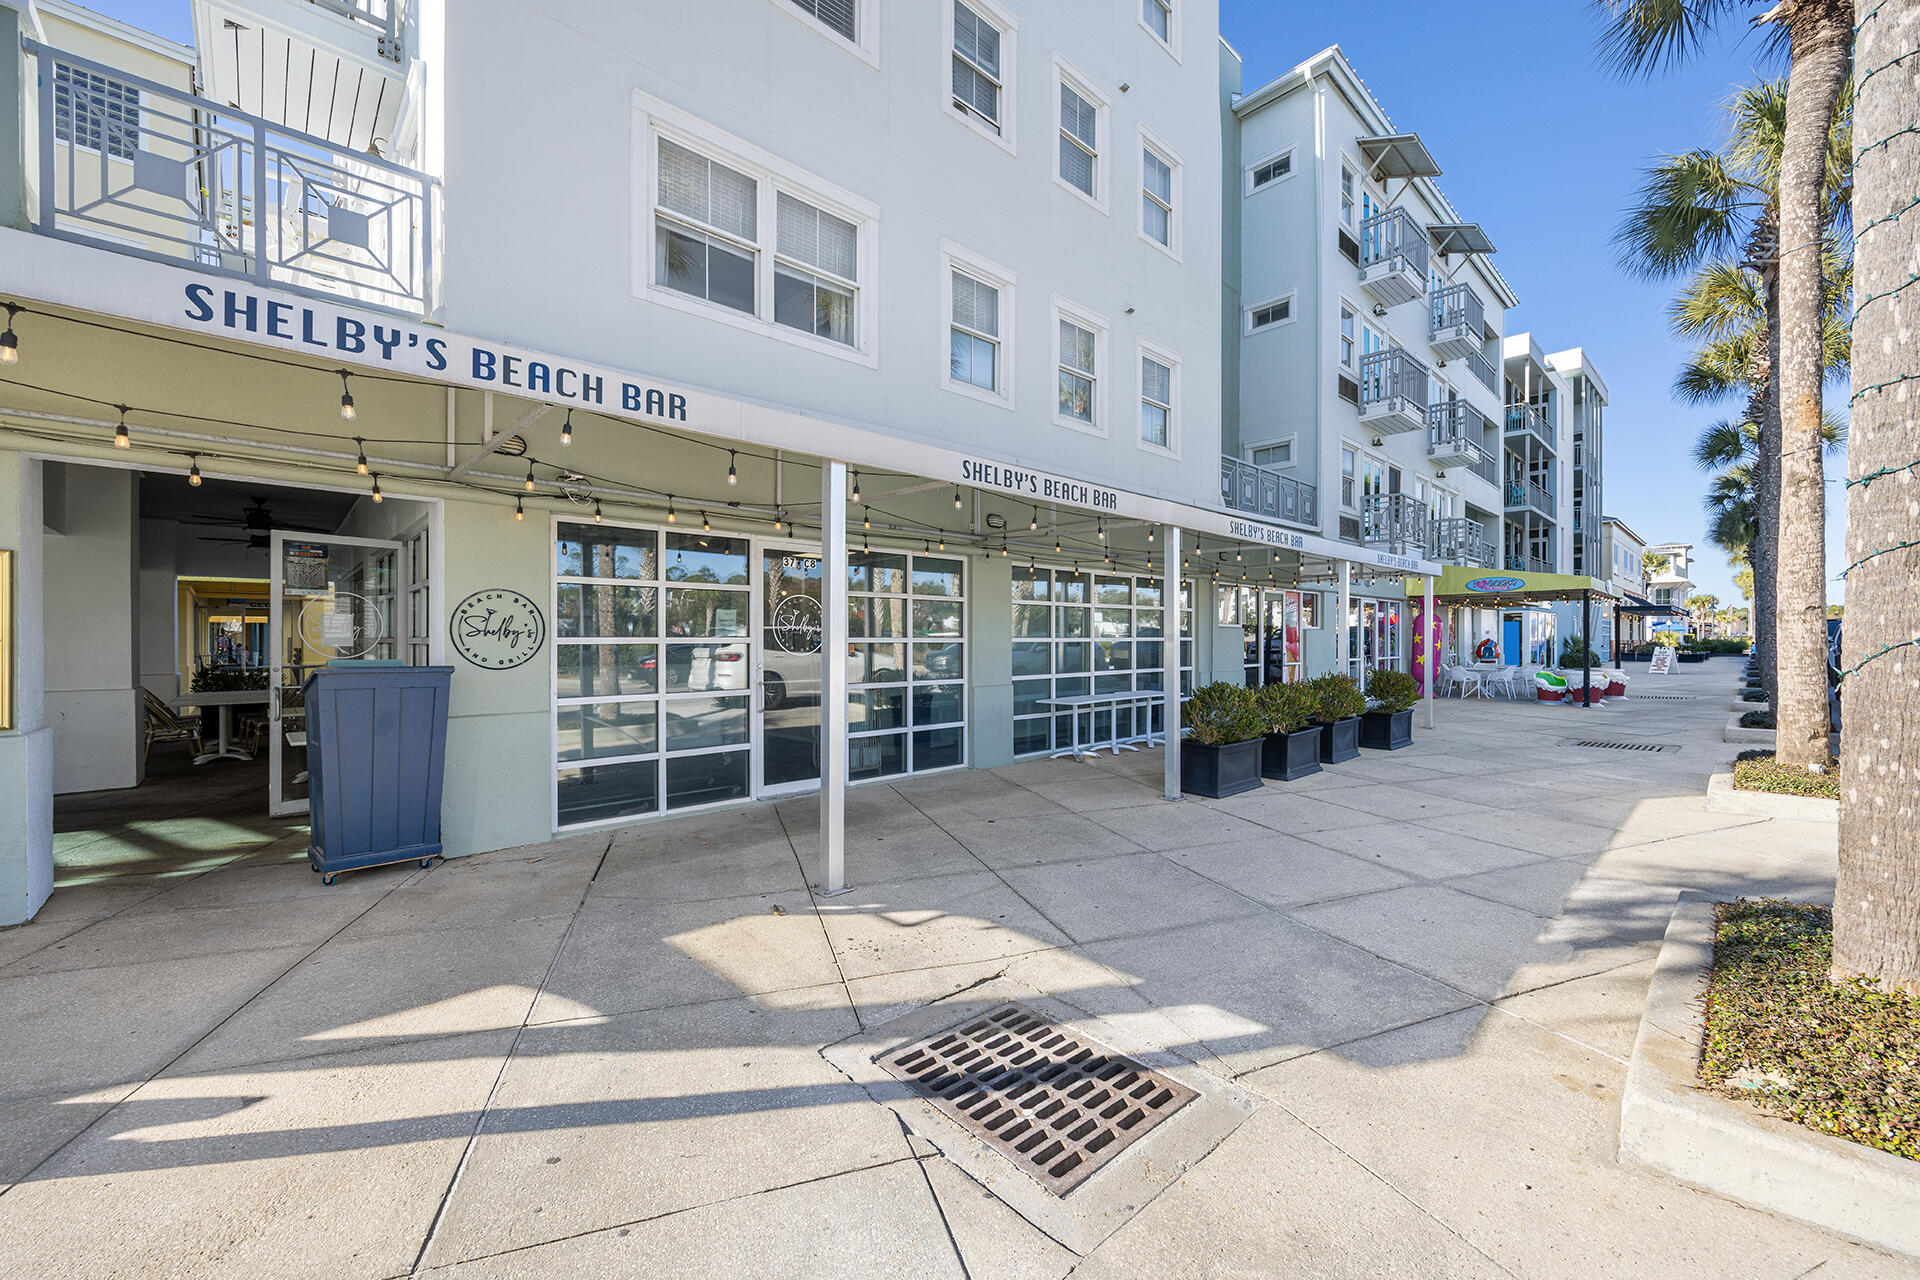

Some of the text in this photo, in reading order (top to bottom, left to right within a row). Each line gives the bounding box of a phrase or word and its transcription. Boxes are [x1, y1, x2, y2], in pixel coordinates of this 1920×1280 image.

[184, 283, 687, 421] SHELBY'S BEACH BAR
[962, 459, 1117, 510] SHELBY'S BEACH BAR
[1229, 520, 1304, 549] SHELBY'S BEACH BAR
[783, 557, 816, 569] 37 C8
[460, 593, 535, 616] BEACH BAR
[463, 607, 535, 649] Shelby's
[464, 645, 534, 665] AND GRILL
